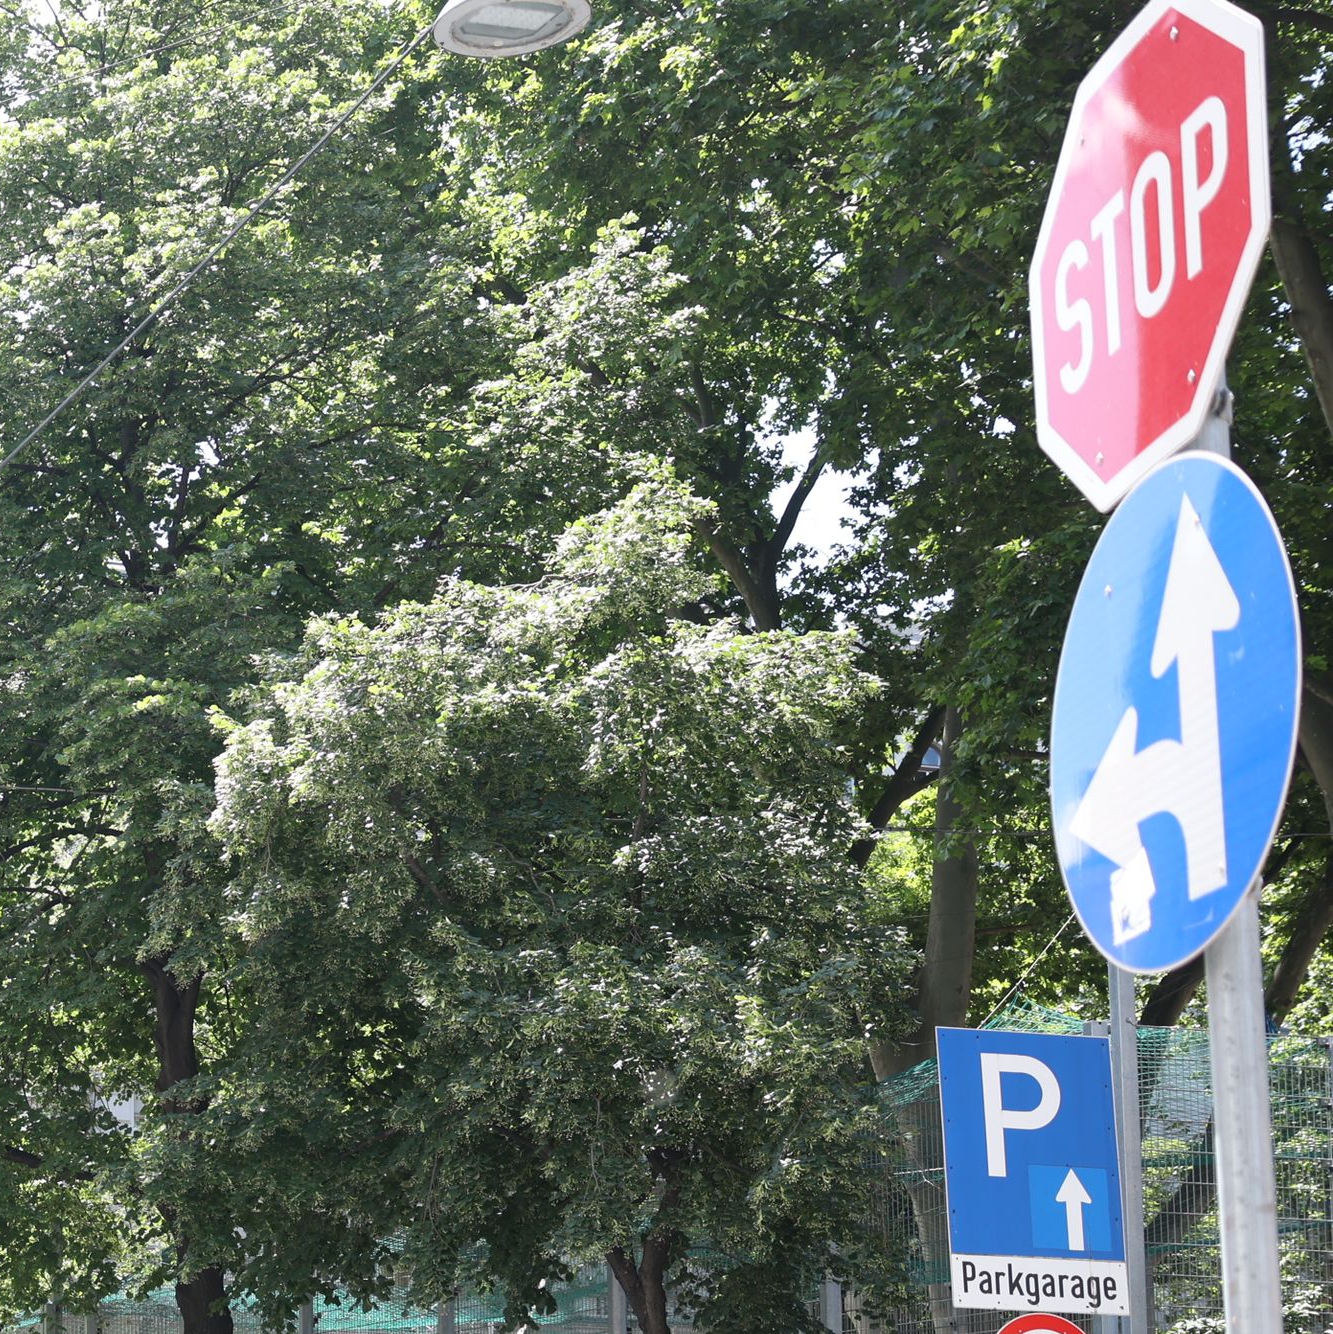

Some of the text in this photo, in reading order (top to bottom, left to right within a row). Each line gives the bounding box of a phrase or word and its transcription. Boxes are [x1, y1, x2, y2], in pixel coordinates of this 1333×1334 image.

[1054, 95, 1229, 394] STOP
[979, 1052, 1061, 1178] P
[961, 1260, 1118, 1308] Parkgarage
